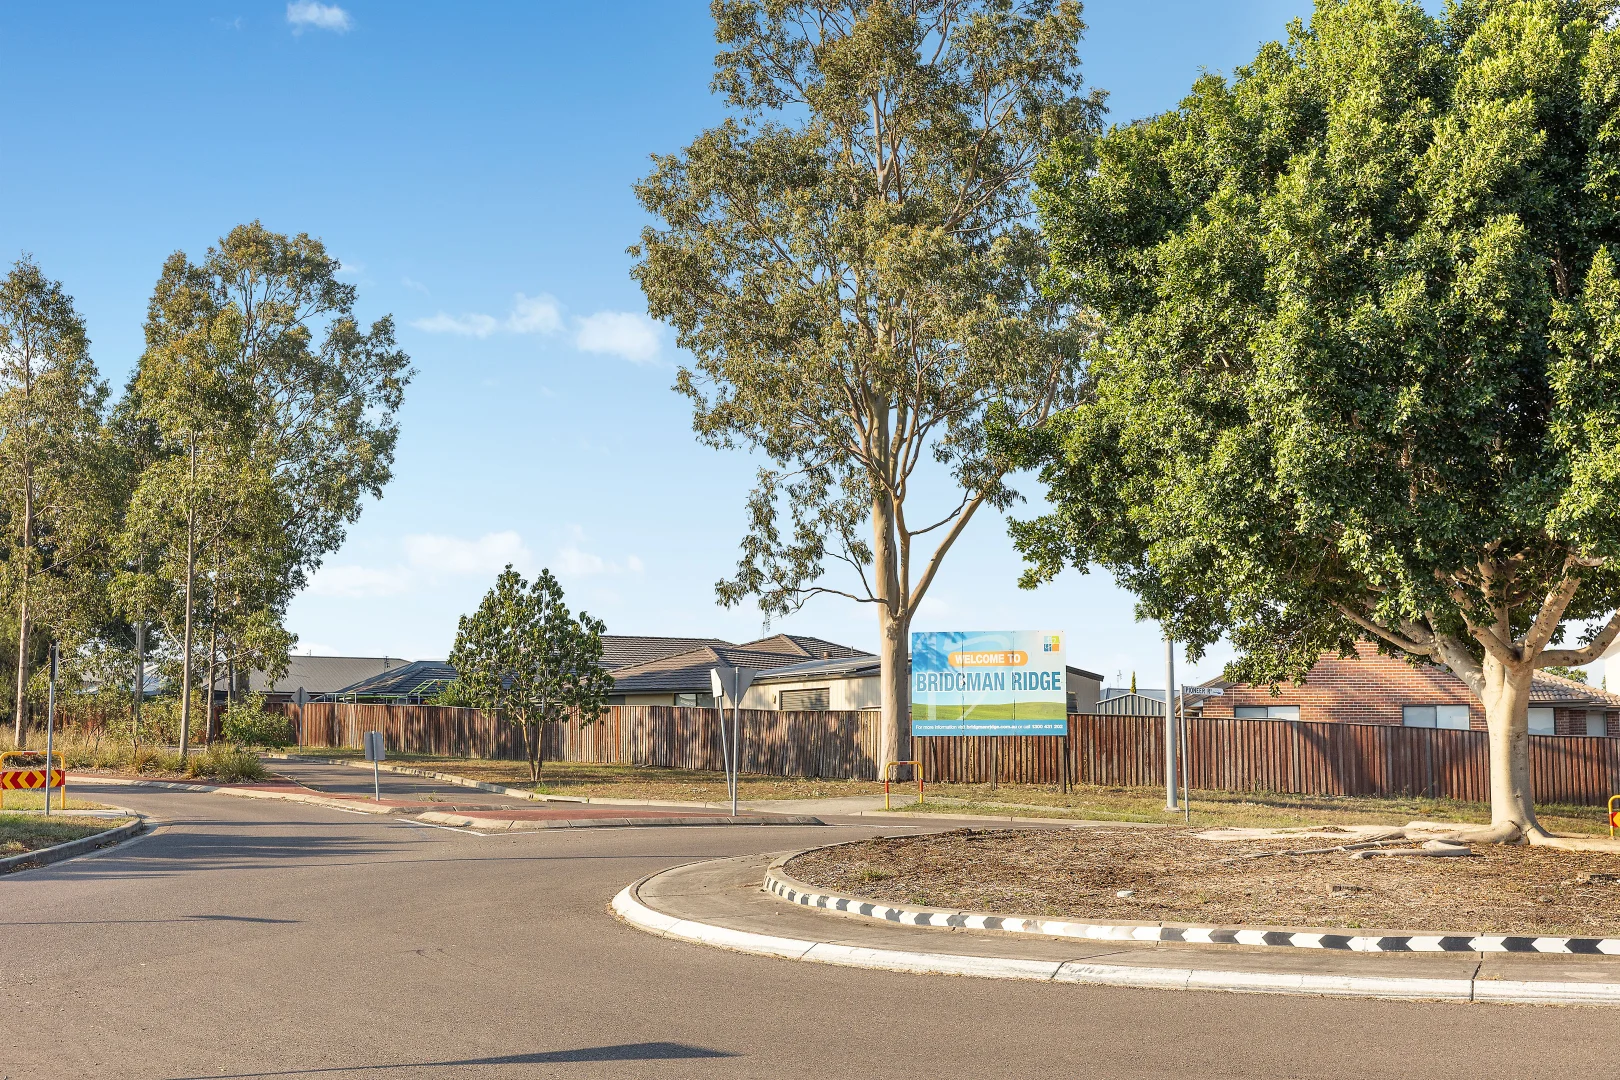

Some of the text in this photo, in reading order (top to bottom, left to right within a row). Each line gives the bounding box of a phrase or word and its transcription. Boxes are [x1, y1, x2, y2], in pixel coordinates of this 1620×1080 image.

[955, 654, 1021, 664] WELCOME TO
[916, 671, 1061, 692] BRIDGMAN RIDGE
[1185, 686, 1206, 695] PIONEER
